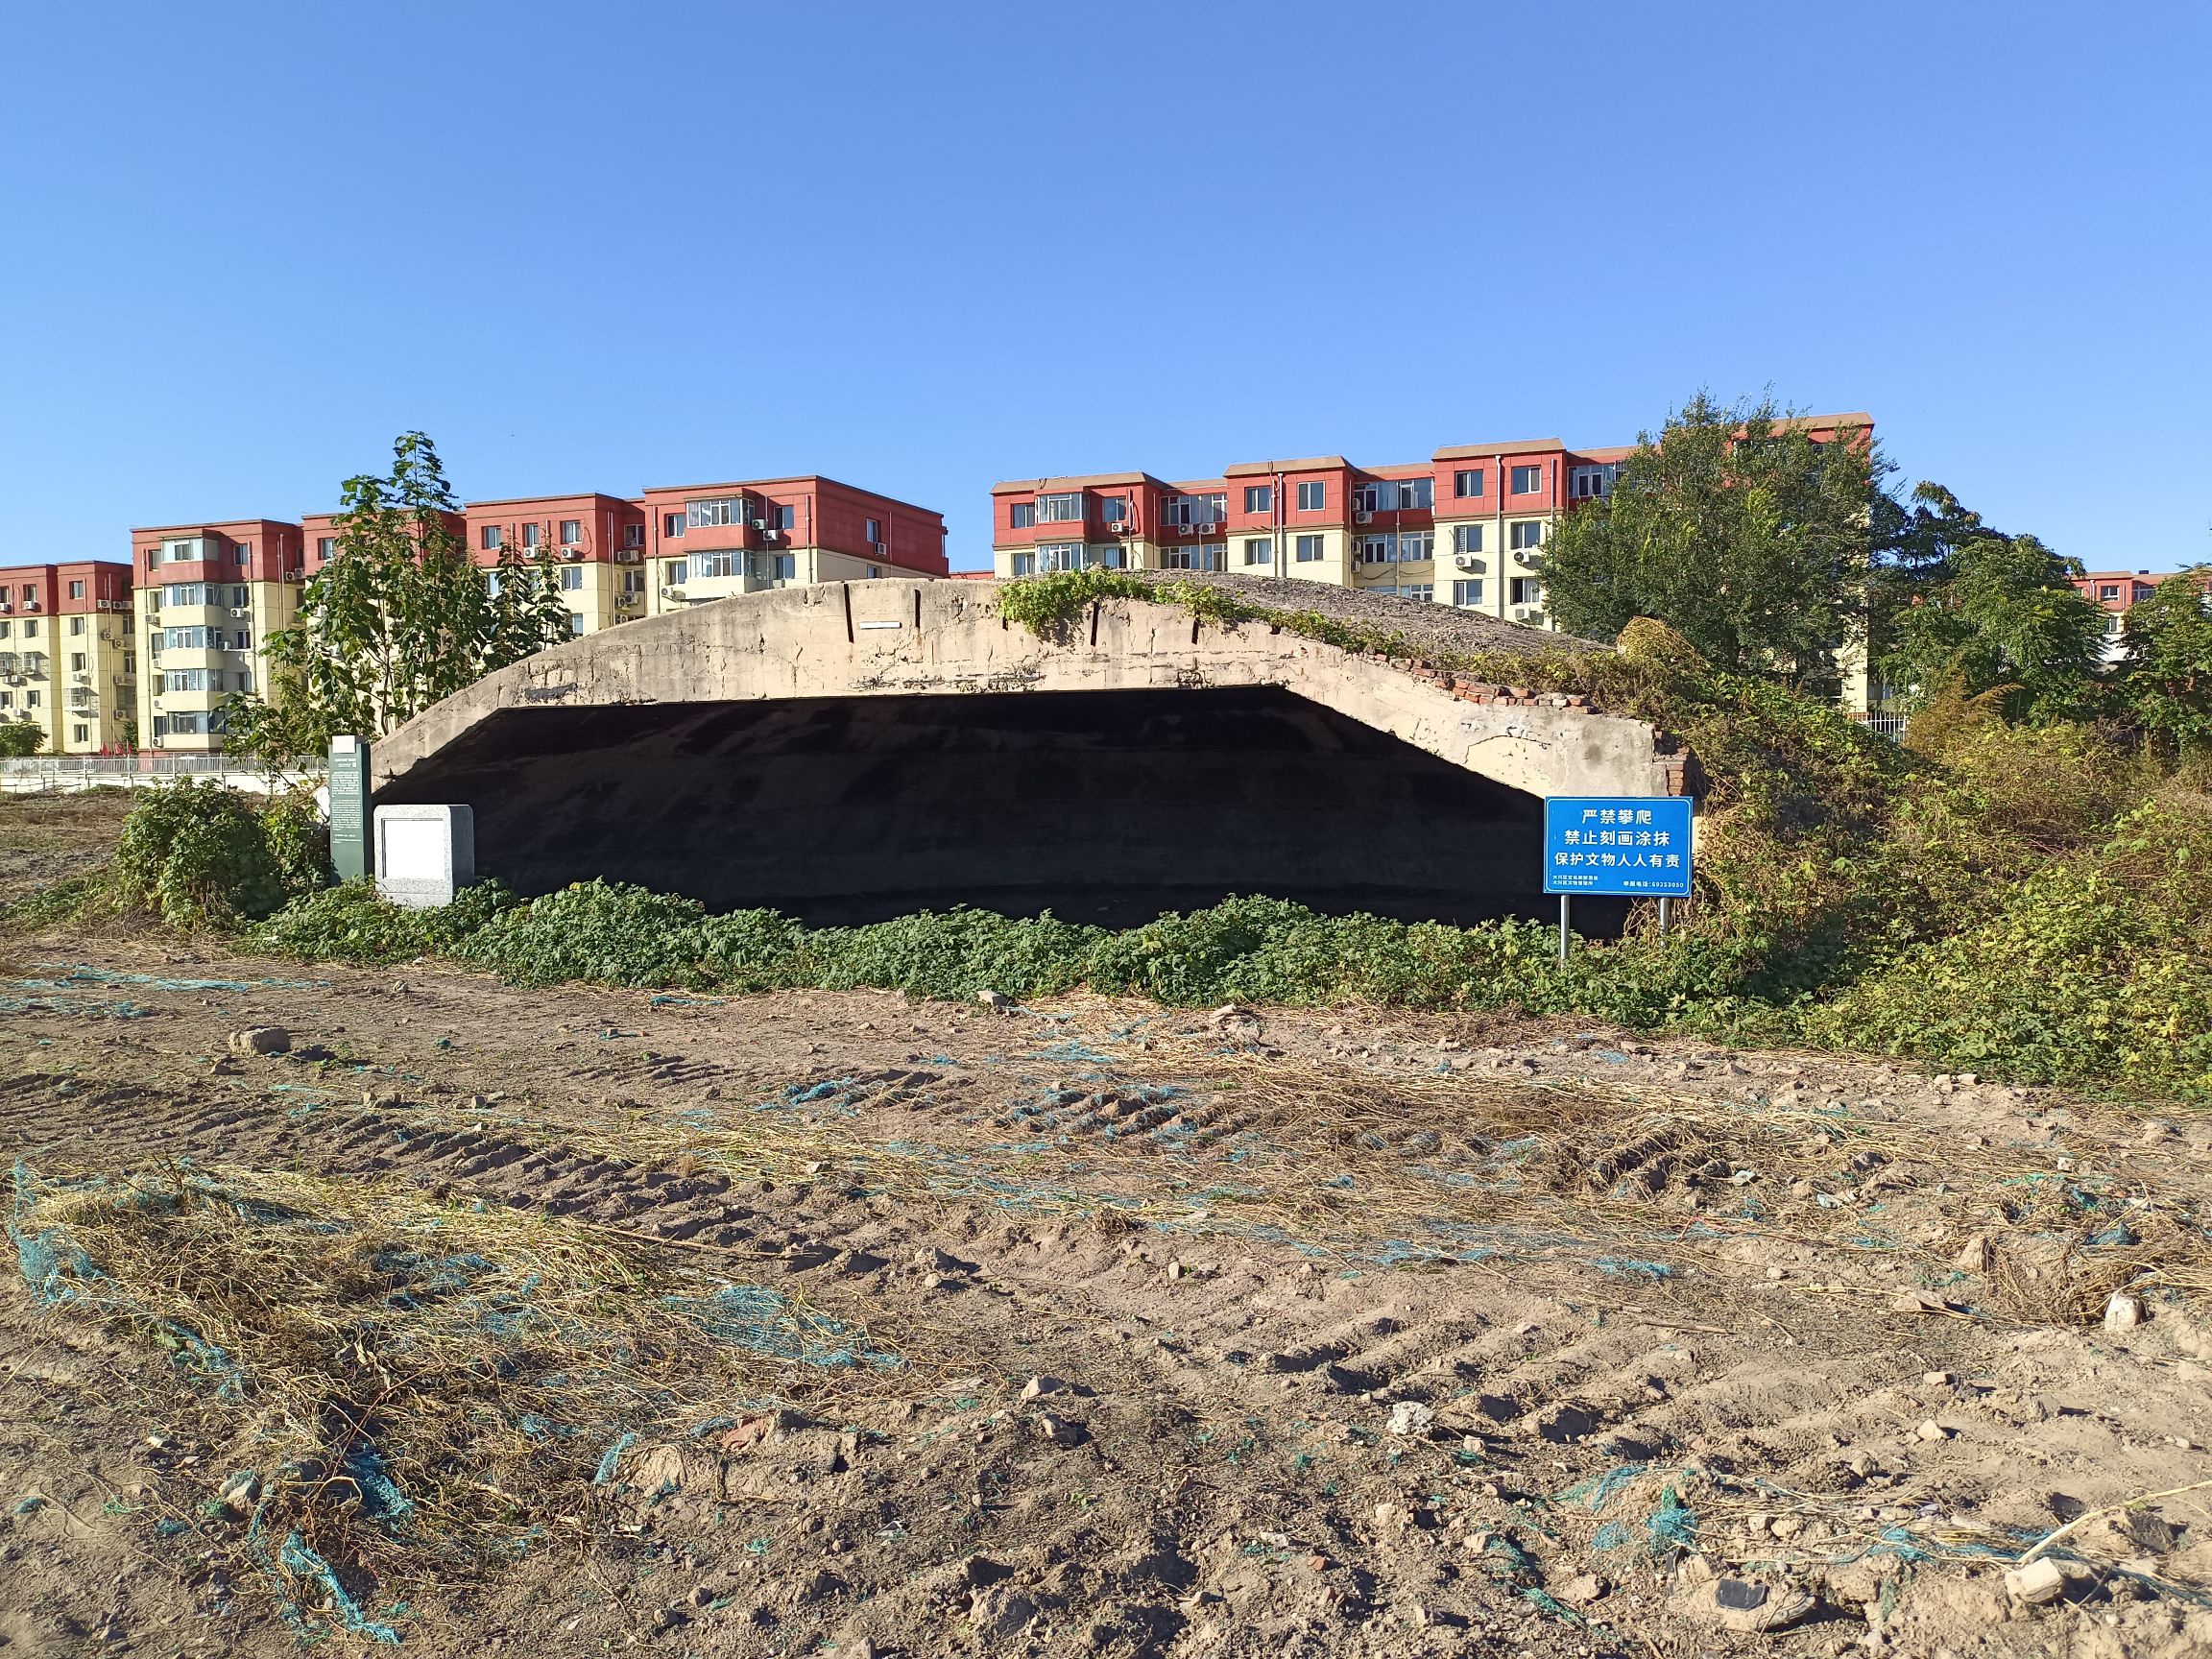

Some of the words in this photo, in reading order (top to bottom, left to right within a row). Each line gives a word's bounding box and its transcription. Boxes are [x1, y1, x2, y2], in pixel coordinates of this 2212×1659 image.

[1581, 808, 1652, 825] 严禁攀爬
[1564, 830, 1671, 847] 禁止刻画涂抹
[1554, 852, 1680, 868] 保护文物人人有责
